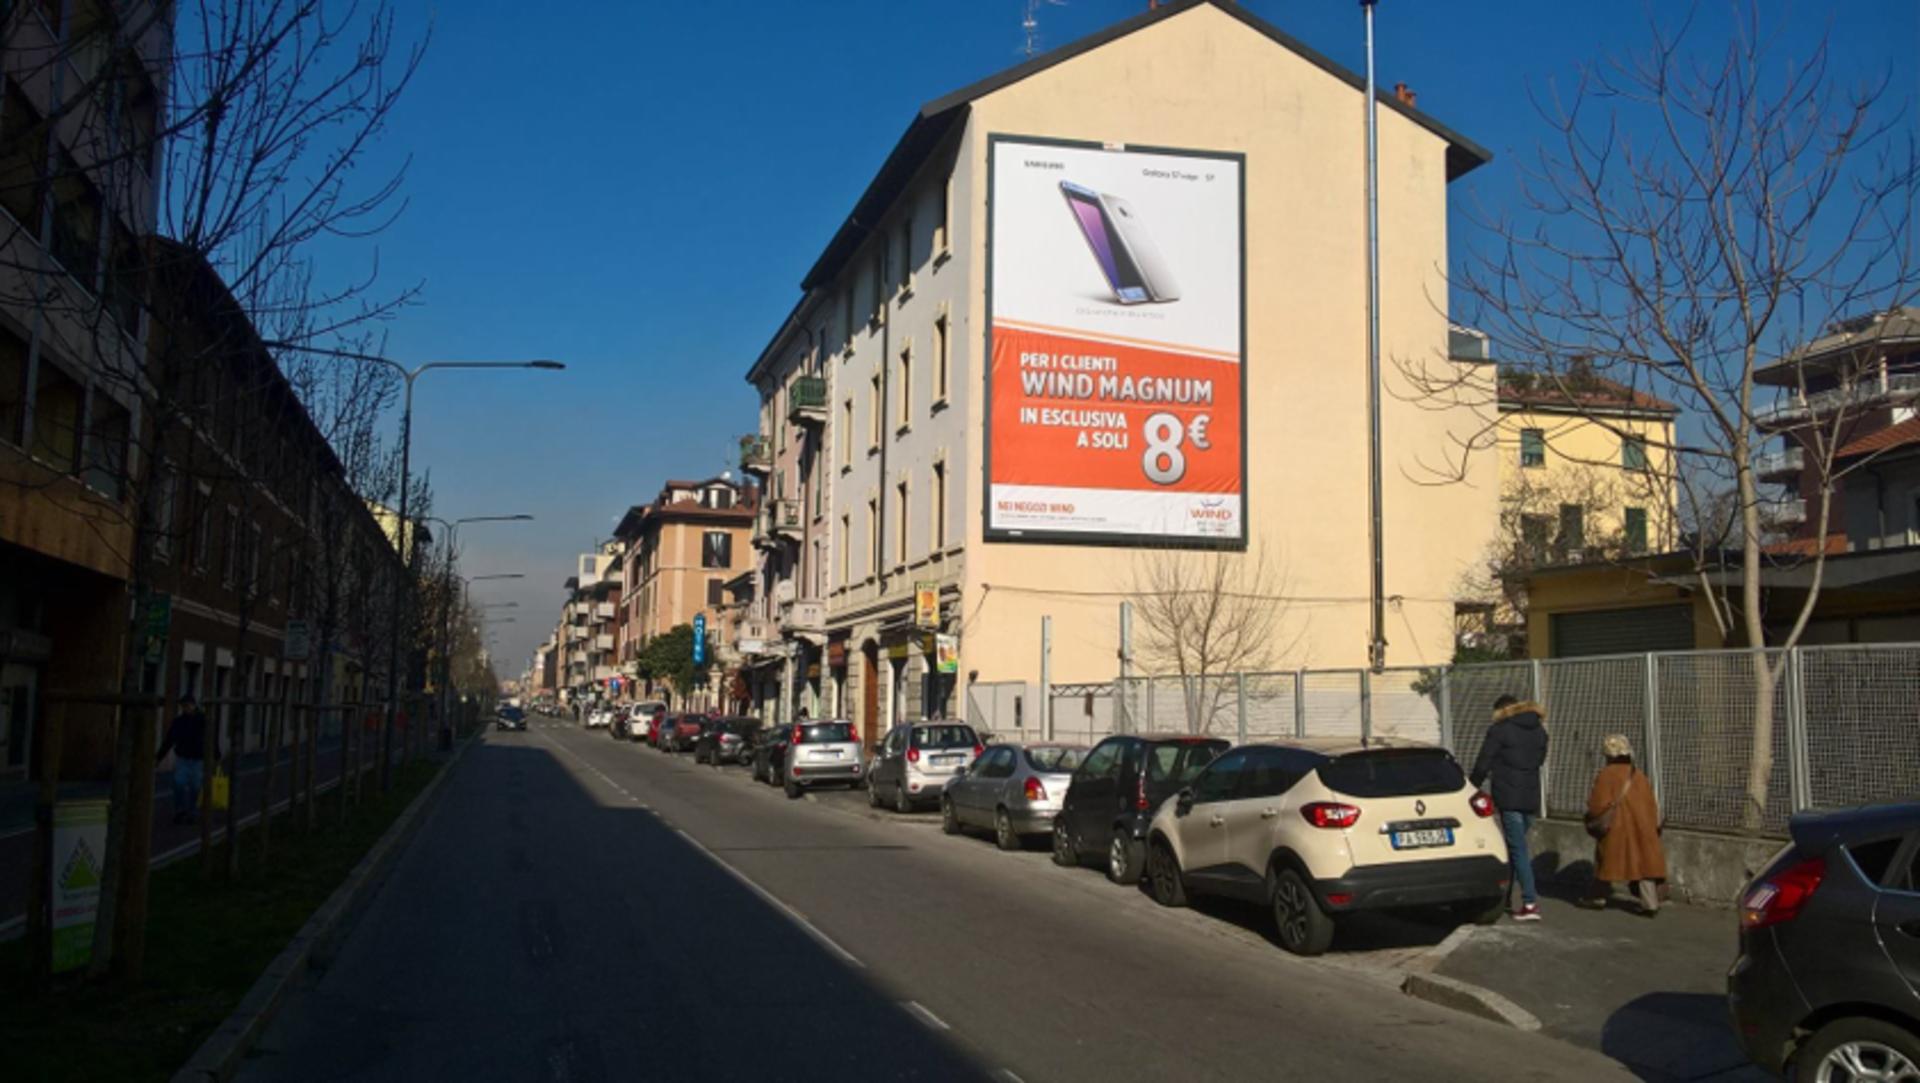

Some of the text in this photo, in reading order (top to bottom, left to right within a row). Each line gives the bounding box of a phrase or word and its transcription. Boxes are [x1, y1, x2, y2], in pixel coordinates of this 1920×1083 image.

[1020, 352, 1118, 372] PER I CLIENTI
[1020, 369, 1213, 404] WIND MAGNUM
[1020, 407, 1128, 429] IN ESCLUSIVA
[1076, 431, 1128, 449] A SOLI
[1190, 508, 1233, 521] WIND
[694, 618, 704, 662] HOTEL
